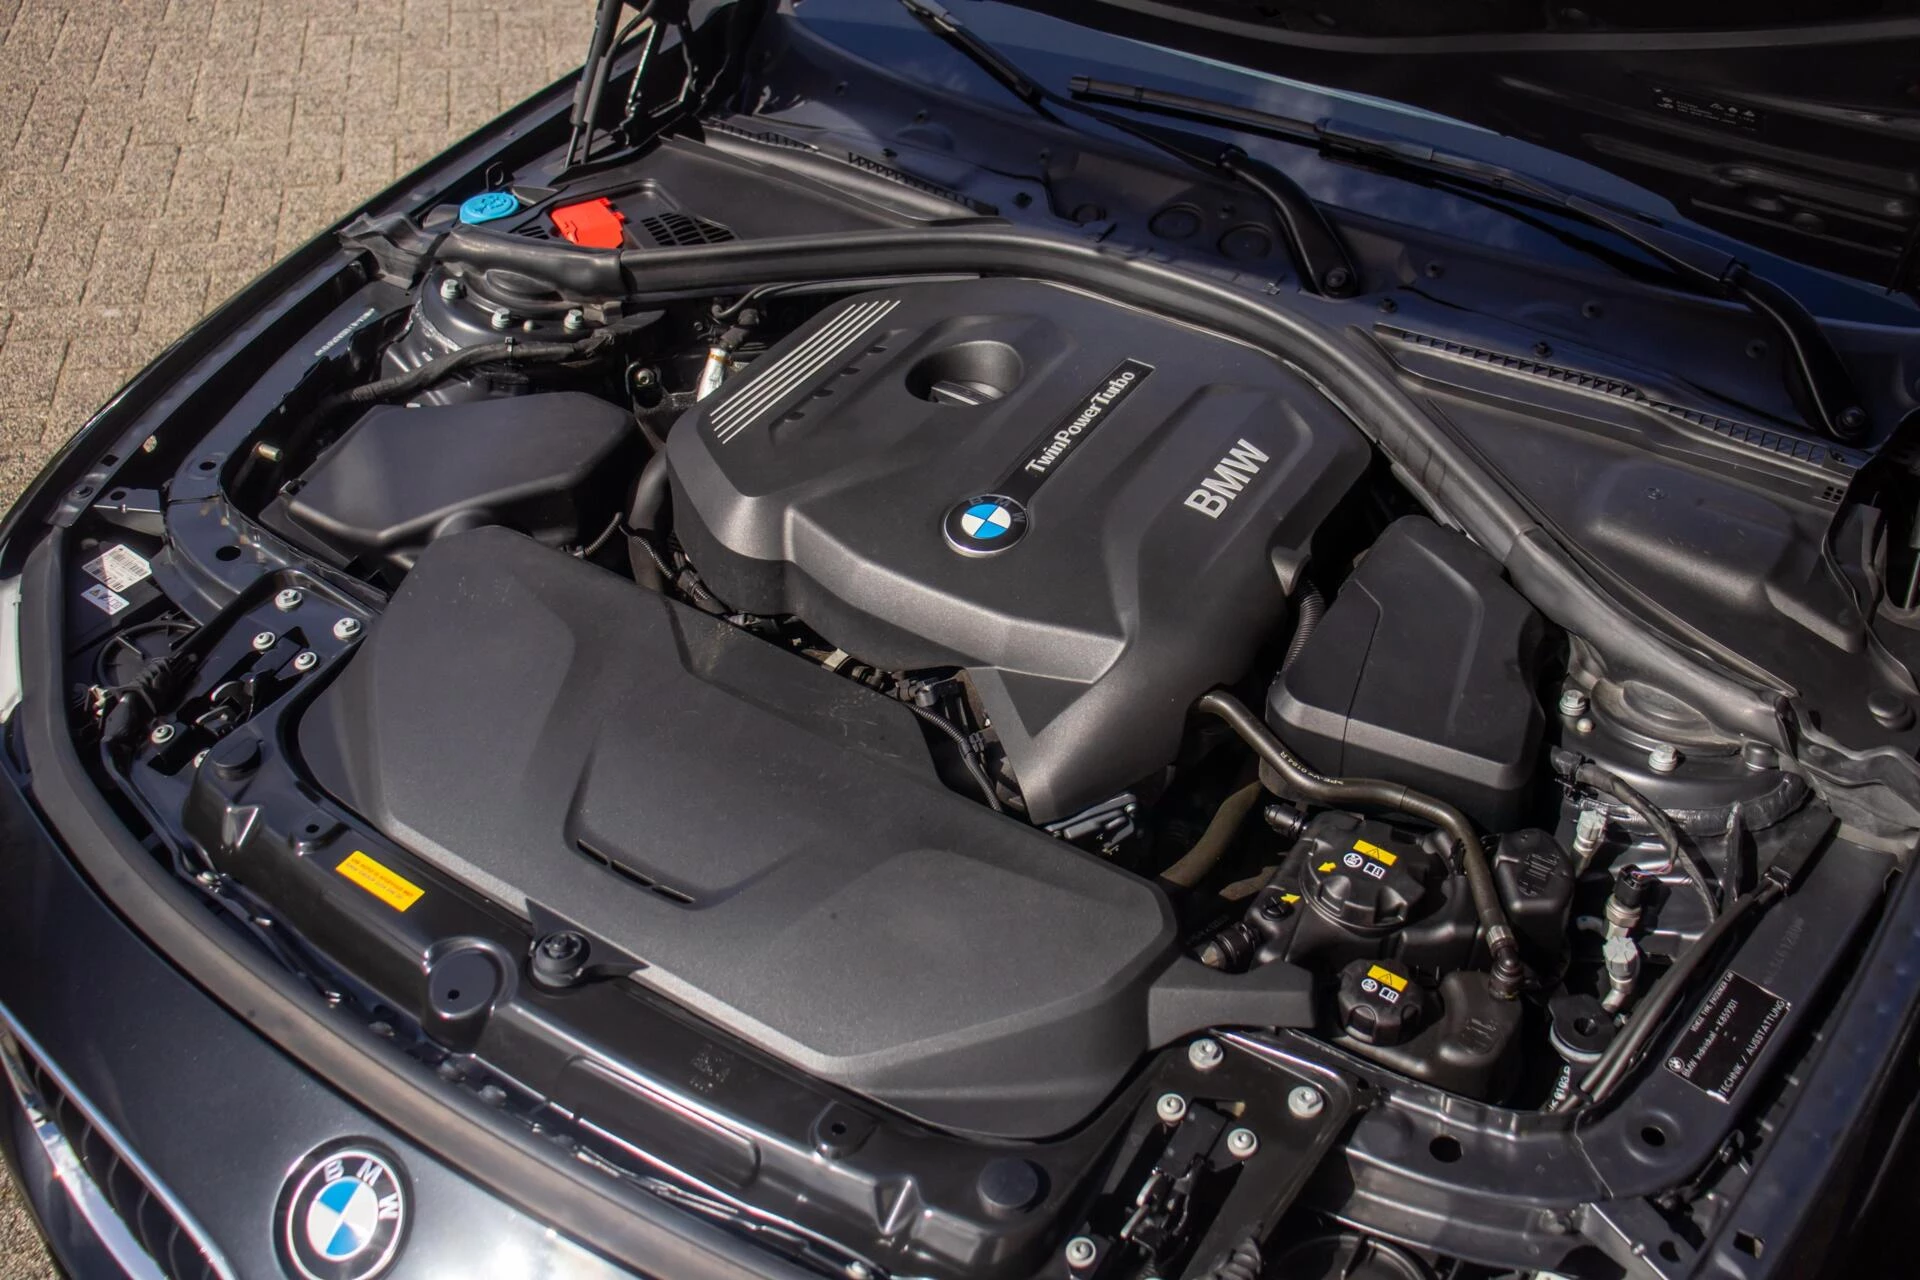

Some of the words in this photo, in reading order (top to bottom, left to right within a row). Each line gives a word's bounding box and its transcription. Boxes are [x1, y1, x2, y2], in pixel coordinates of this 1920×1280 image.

[1184, 438, 1270, 519] BMW
[1746, 1000, 1785, 1056] AUSSTATTUNG
[1682, 1058, 1699, 1078] BMW
[324, 1158, 400, 1220] BMW
